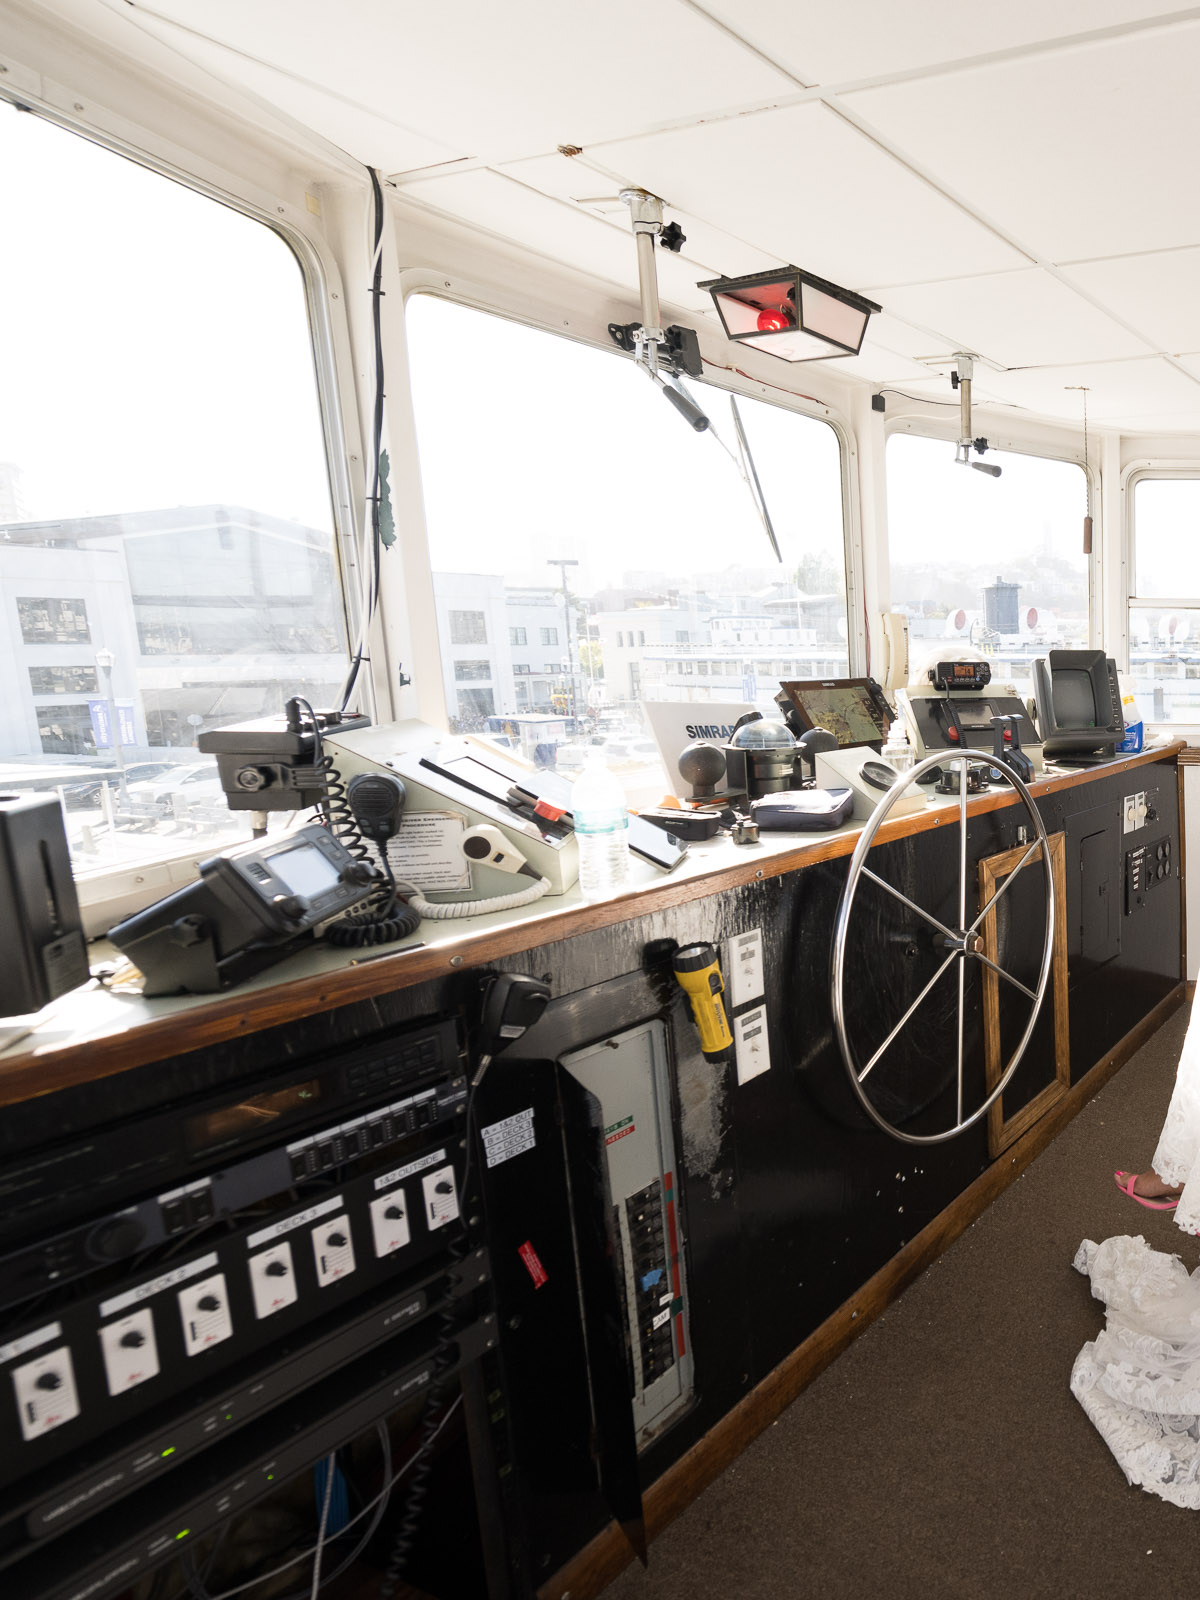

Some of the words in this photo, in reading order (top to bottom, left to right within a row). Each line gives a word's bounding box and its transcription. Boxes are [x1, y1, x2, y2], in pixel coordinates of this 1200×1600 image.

[499, 1119, 513, 1130] 1&2
[515, 1110, 532, 1123] OUT
[502, 1123, 525, 1139] DECK
[503, 1133, 526, 1148] DECK
[505, 1144, 527, 1158] DECK
[379, 1173, 398, 1187] 1&2
[399, 1153, 441, 1178] OUTSIDE
[275, 1214, 307, 1235] DECK
[135, 1275, 173, 1300] DECK
